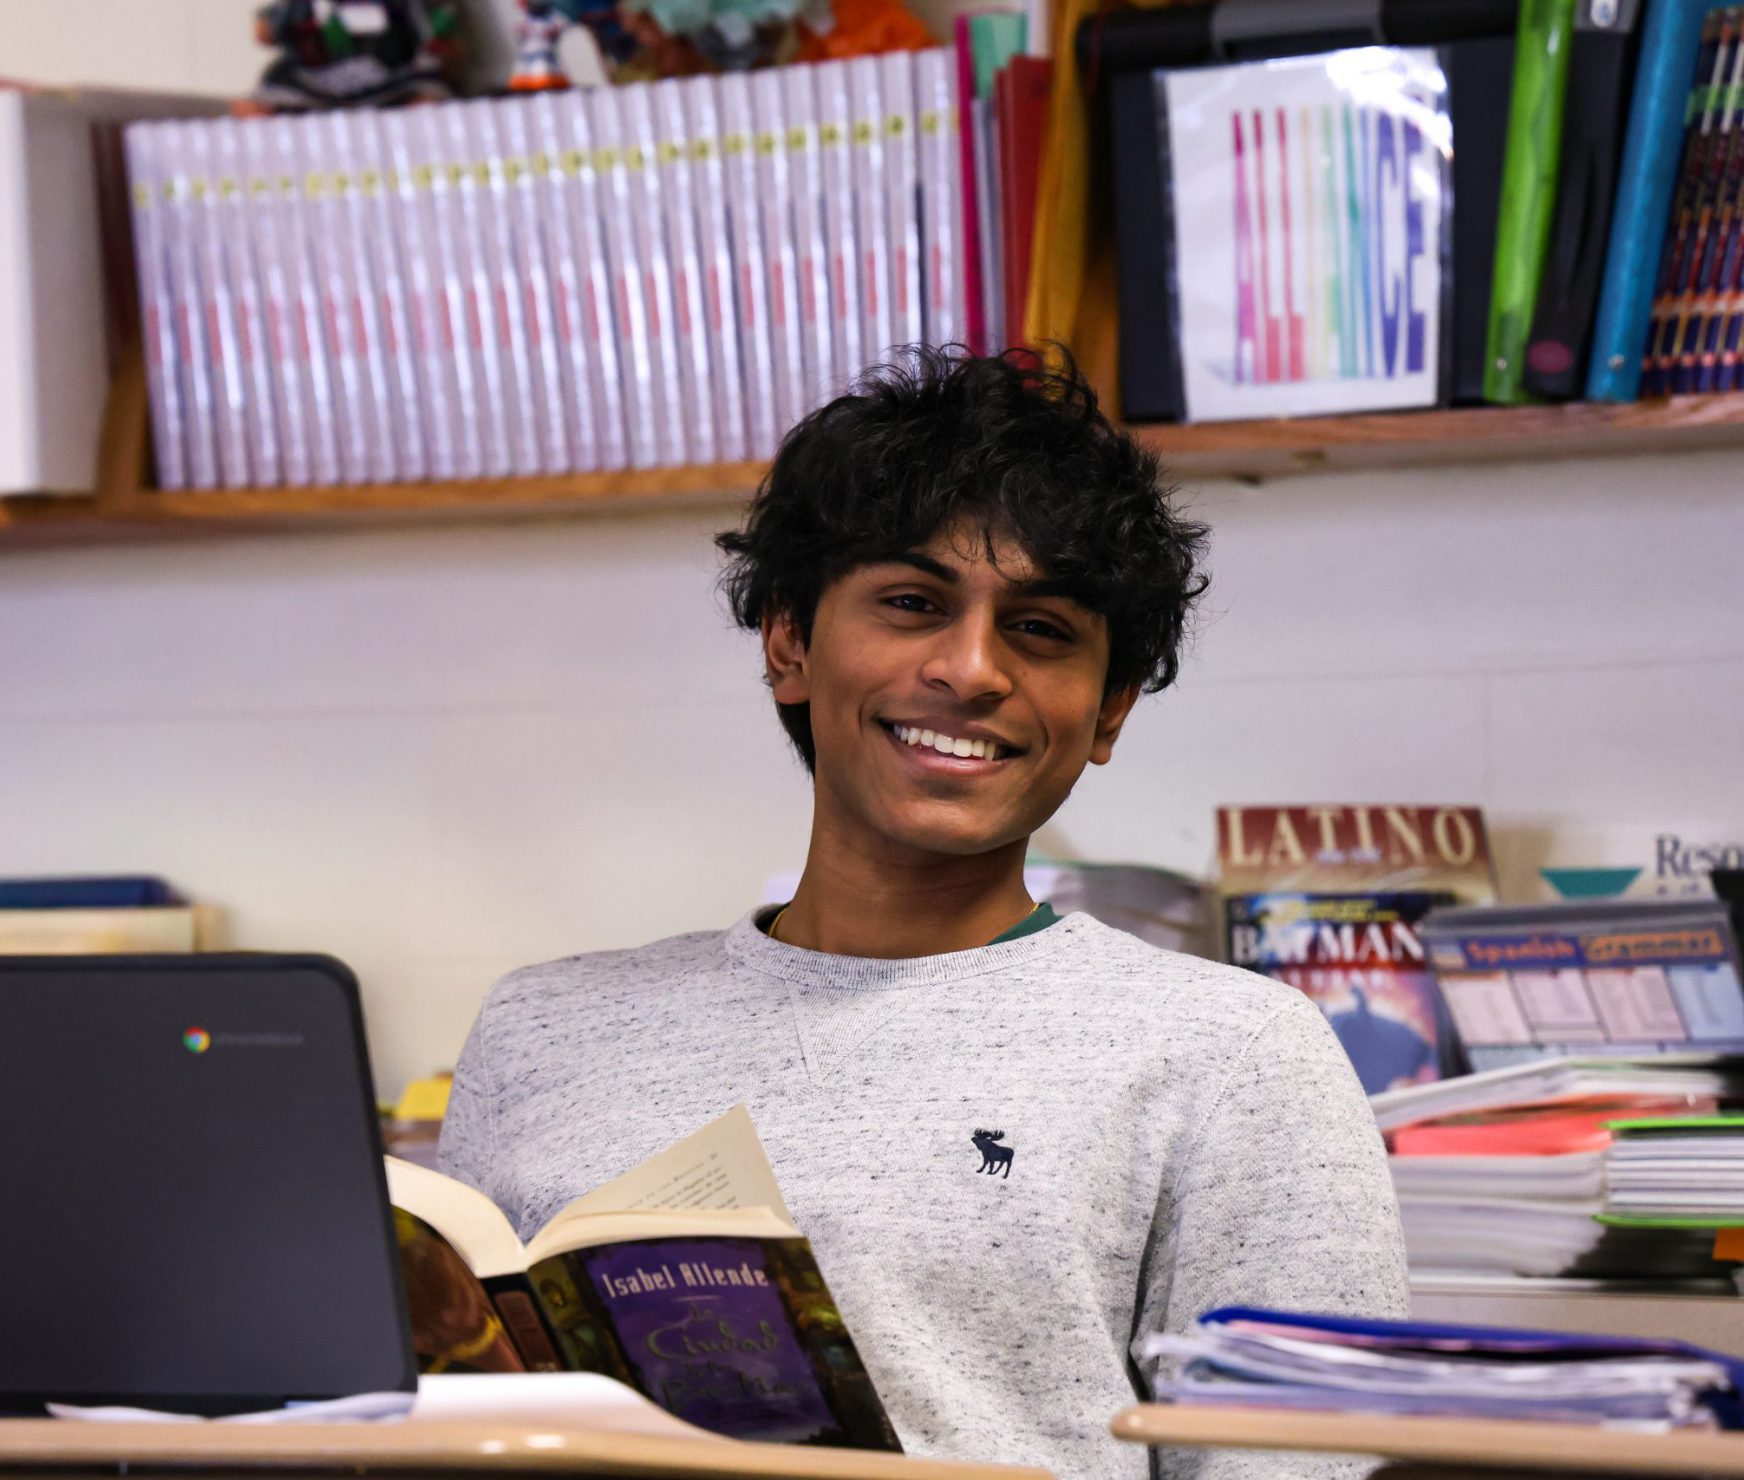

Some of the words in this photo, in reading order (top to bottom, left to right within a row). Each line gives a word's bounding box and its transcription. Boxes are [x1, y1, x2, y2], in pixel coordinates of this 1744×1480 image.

[1228, 807, 1475, 867] LATINO
[602, 1264, 676, 1298] Isabel
[679, 1262, 769, 1287] Allende
[646, 1318, 778, 1360] Ciudad
